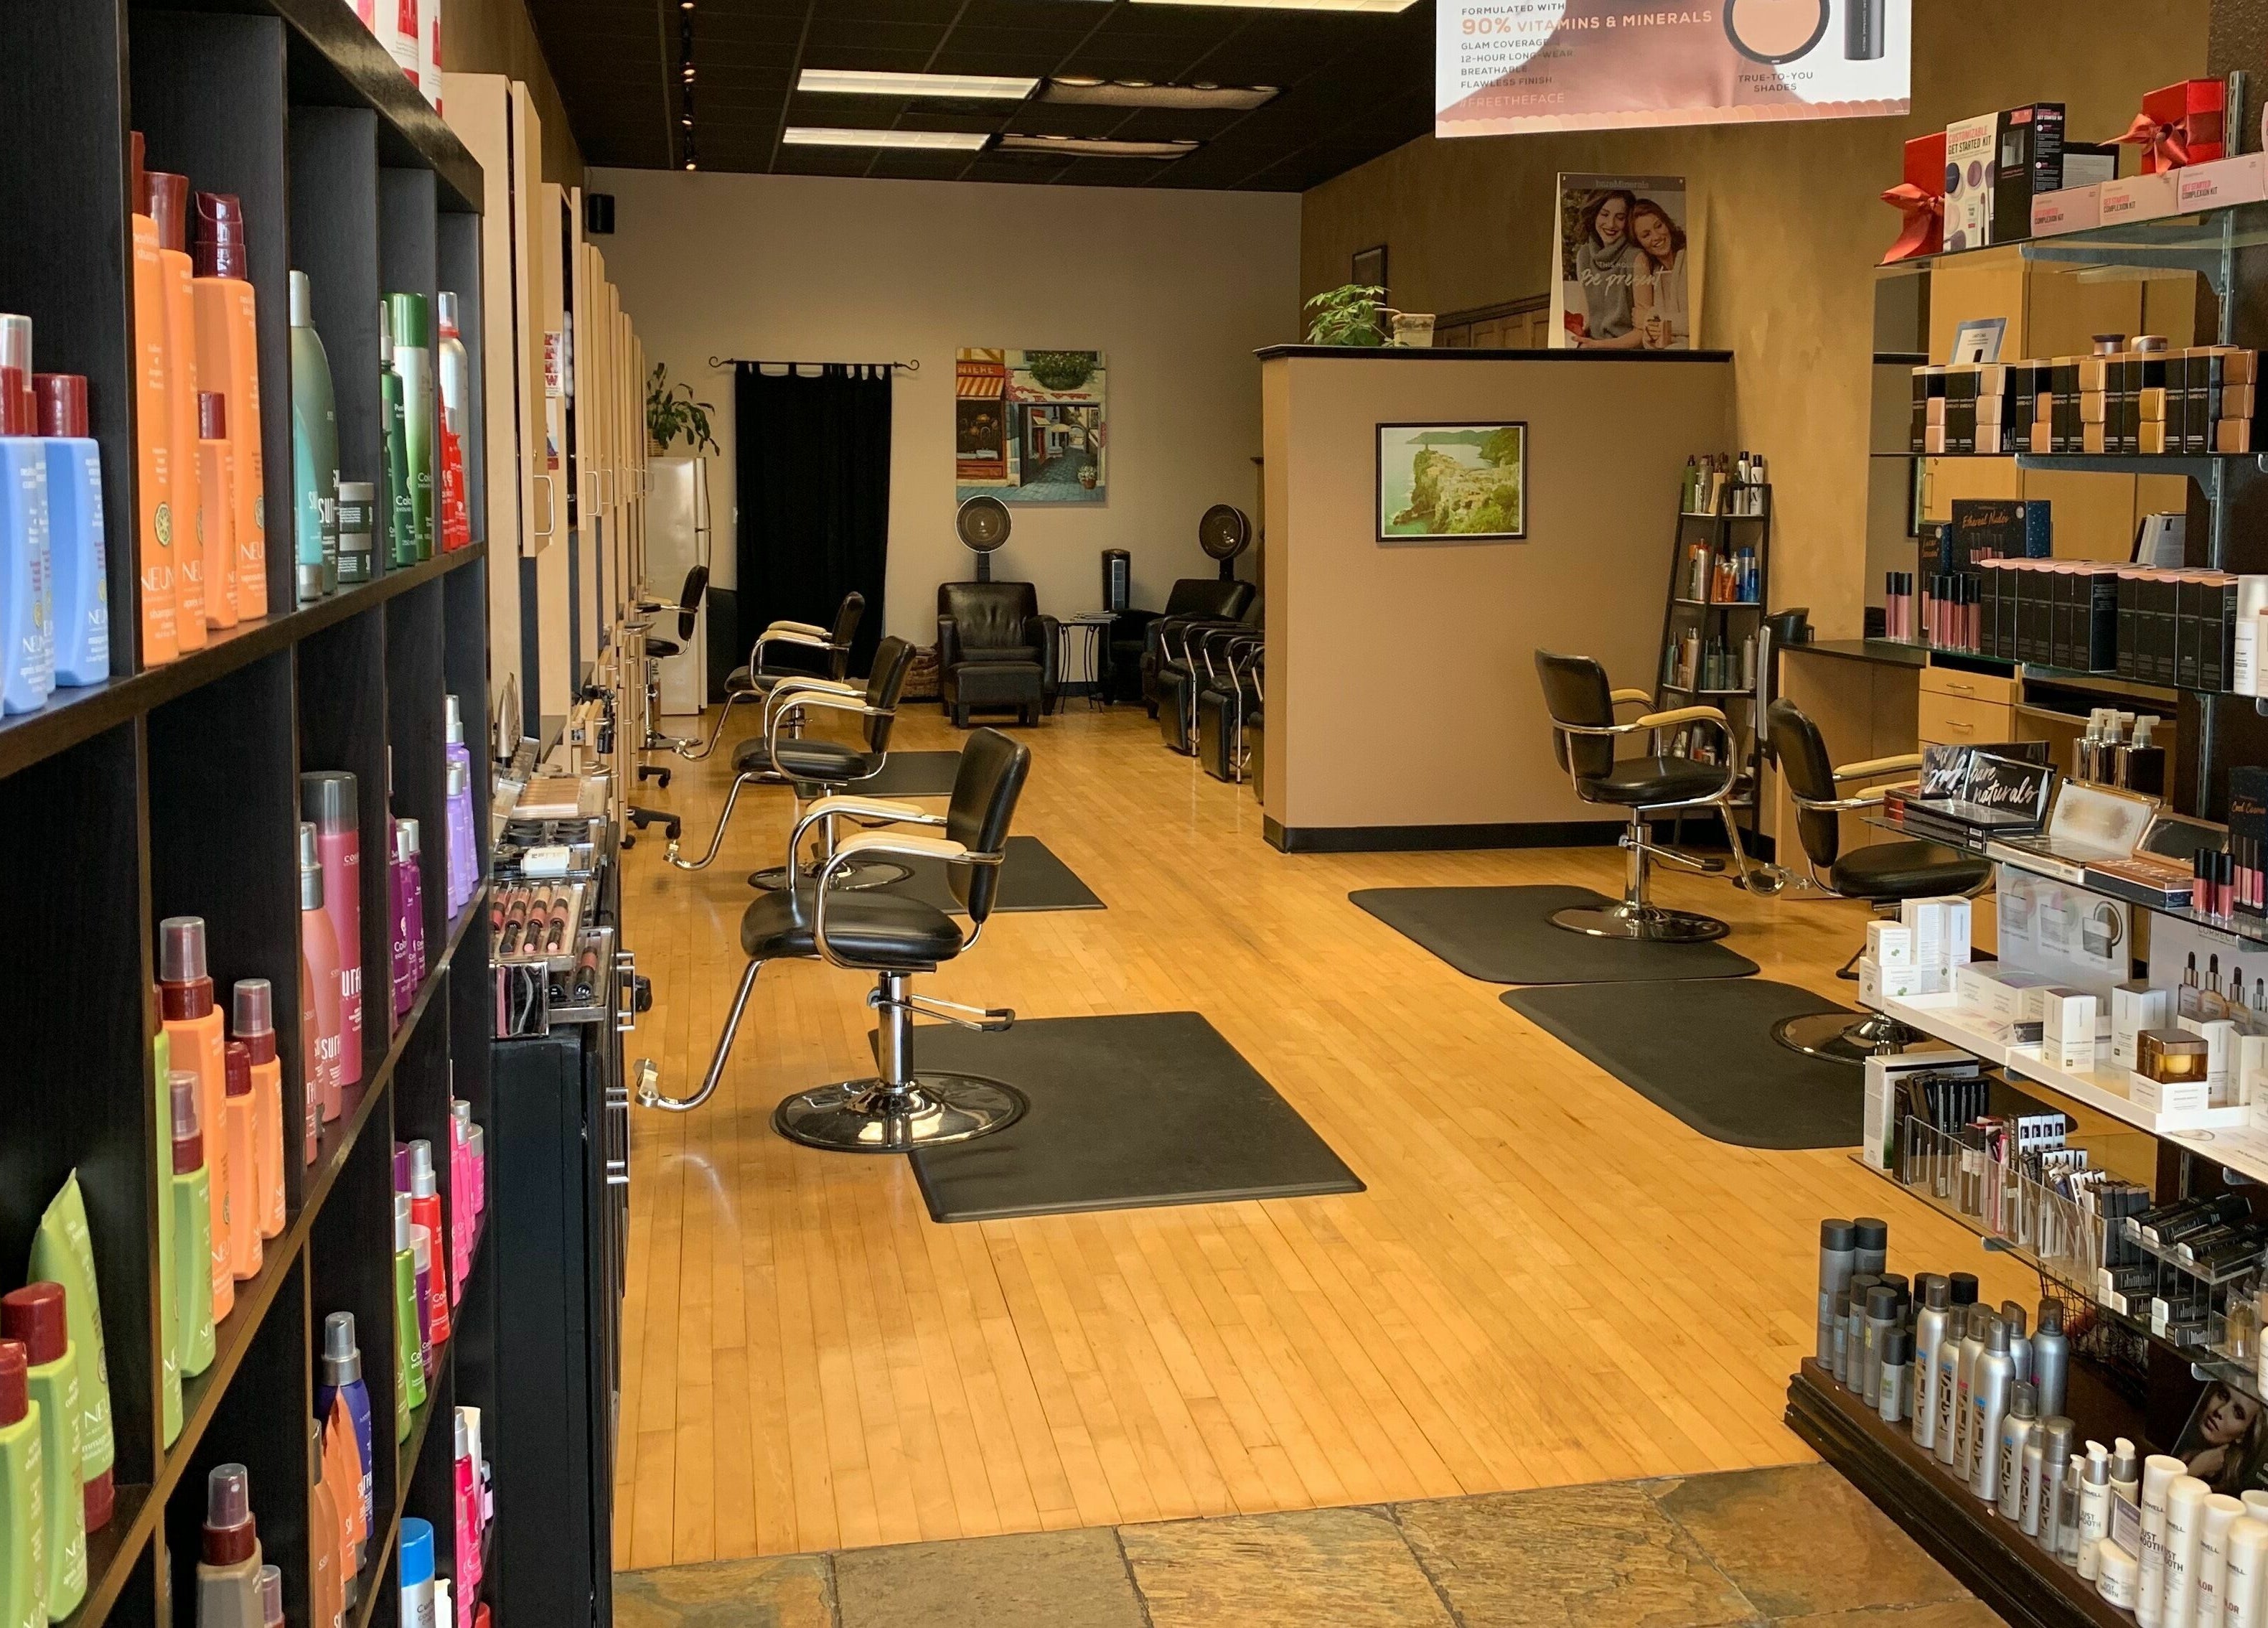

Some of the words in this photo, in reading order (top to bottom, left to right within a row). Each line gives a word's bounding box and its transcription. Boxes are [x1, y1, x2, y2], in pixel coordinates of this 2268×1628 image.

[1461, 4, 1534, 16] FORMULATED
[1537, 2, 1565, 11] WITH
[1461, 17, 1512, 35] 90%
[1517, 16, 1601, 33] VITAMINS
[1606, 17, 1617, 27] &
[1622, 10, 1713, 27] MINERALS
[1461, 41, 1491, 50] GLAM
[1493, 38, 1550, 49] COVERAGE
[1461, 53, 1506, 63] 12-HOUR
[1509, 50, 1574, 60] LONG-WEAR
[1461, 65, 1528, 76] BREATHABLE
[1461, 79, 1517, 89] FLAWLESS
[1518, 76, 1552, 87] FINISH
[1738, 72, 1814, 83] TRUE-TO-YOU
[1754, 83, 1797, 93] SHADES
[1460, 93, 1565, 108] #FREETHEFACE
[1948, 144, 1959, 155] GET
[1959, 139, 1981, 153] STARTED
[1982, 135, 1992, 146] KIT
[1972, 776, 2040, 806] naturals
